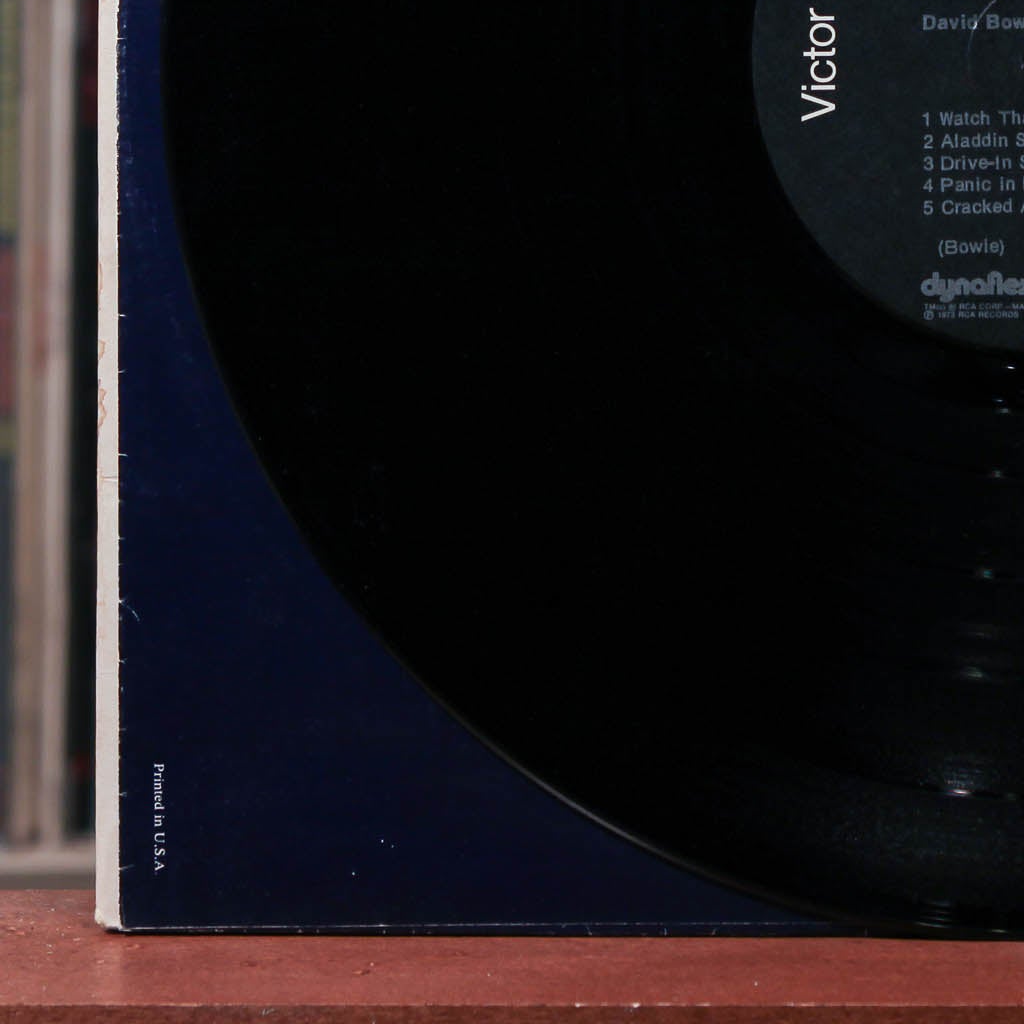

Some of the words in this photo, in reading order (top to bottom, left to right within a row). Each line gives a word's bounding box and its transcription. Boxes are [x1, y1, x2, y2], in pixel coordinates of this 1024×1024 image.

[923, 14, 979, 32] David
[801, 8, 836, 121] Victor
[922, 112, 929, 126] 1
[940, 111, 990, 126] Watch
[924, 135, 933, 149] 2
[941, 133, 1008, 148] Aladdin
[924, 156, 934, 171] 3
[941, 156, 1011, 170] Drive-In
[923, 178, 933, 192] 4
[941, 177, 991, 192] Panic
[1001, 177, 1015, 191] in
[924, 200, 933, 215] 5
[942, 198, 1012, 214] Cracked
[938, 239, 1004, 258] (Bowie)
[154, 764, 164, 809] Printed
[154, 815, 164, 826] in
